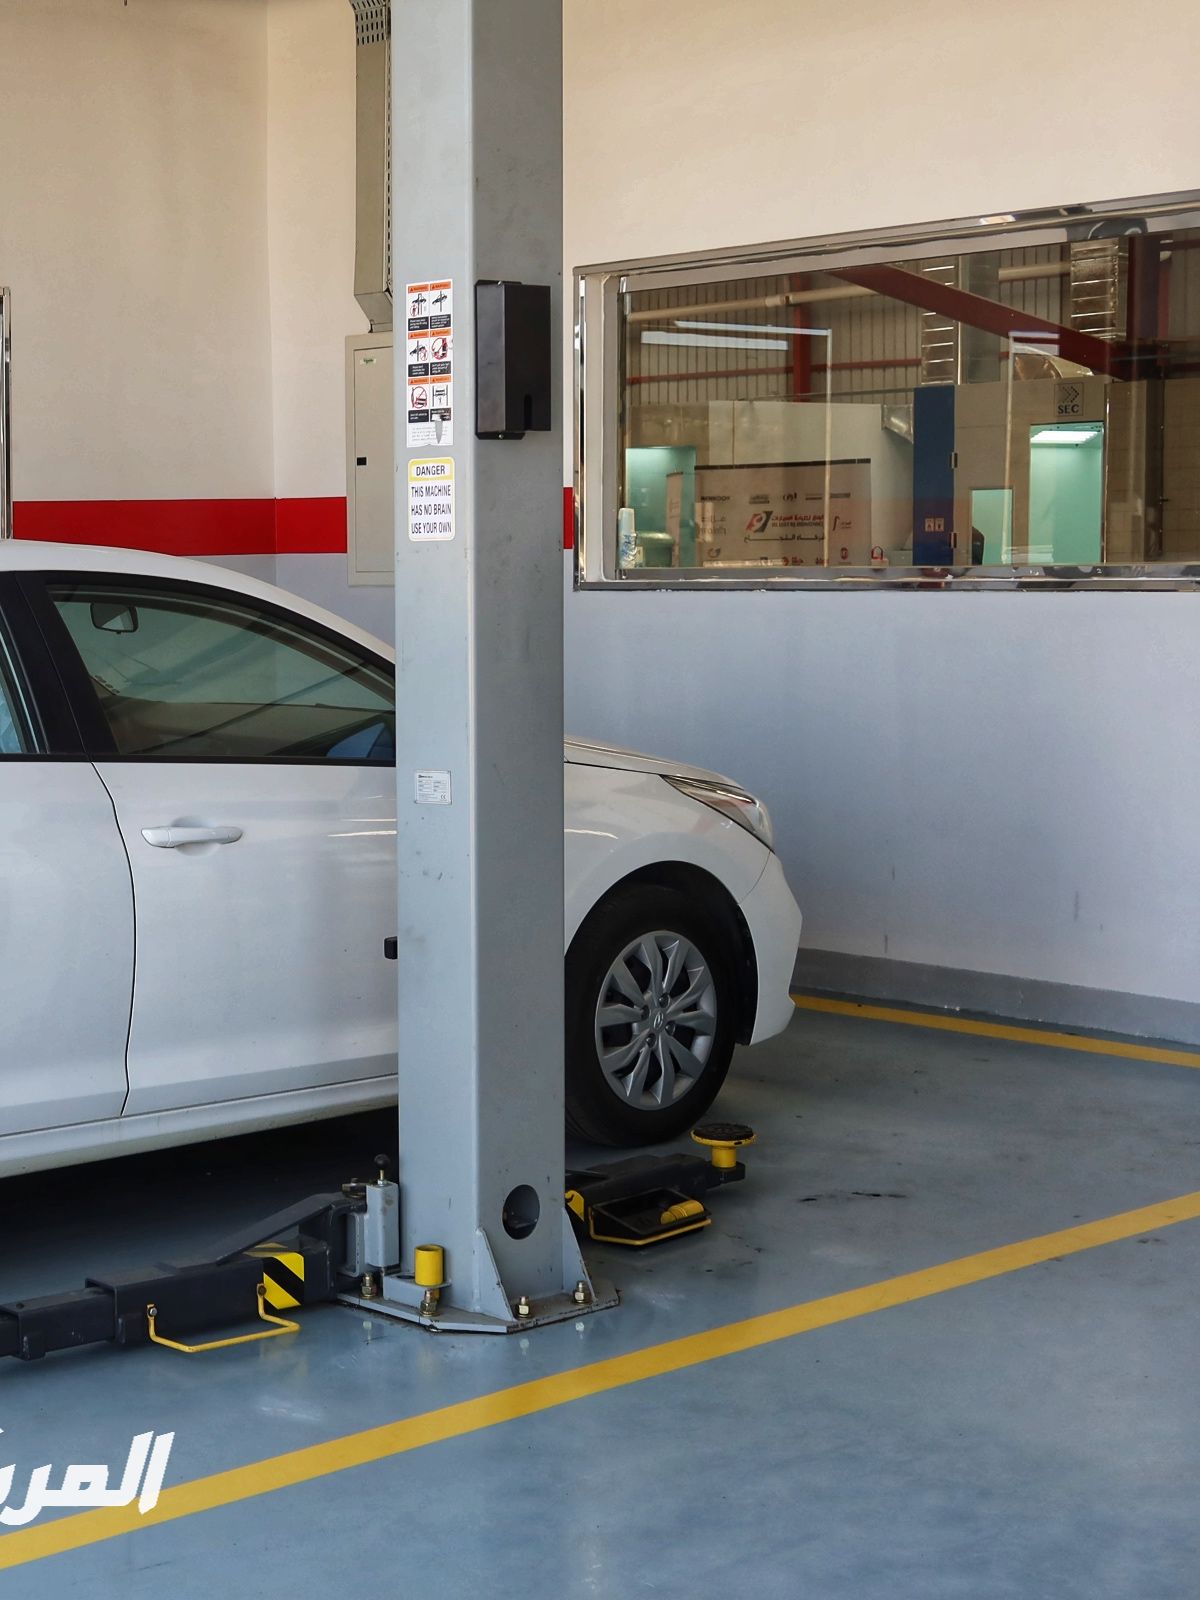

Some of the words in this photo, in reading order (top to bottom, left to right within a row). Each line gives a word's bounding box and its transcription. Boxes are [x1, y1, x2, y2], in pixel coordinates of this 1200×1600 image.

[1057, 404, 1080, 414] SEC
[416, 465, 445, 476] DANGER
[411, 486, 424, 497] THIS
[425, 485, 451, 497] MACHINE
[411, 504, 423, 516] HAS
[424, 504, 432, 515] NO
[434, 503, 452, 515] BRAIN
[411, 522, 422, 534] USE
[422, 522, 437, 533] YOUR
[439, 522, 452, 533] OWN
